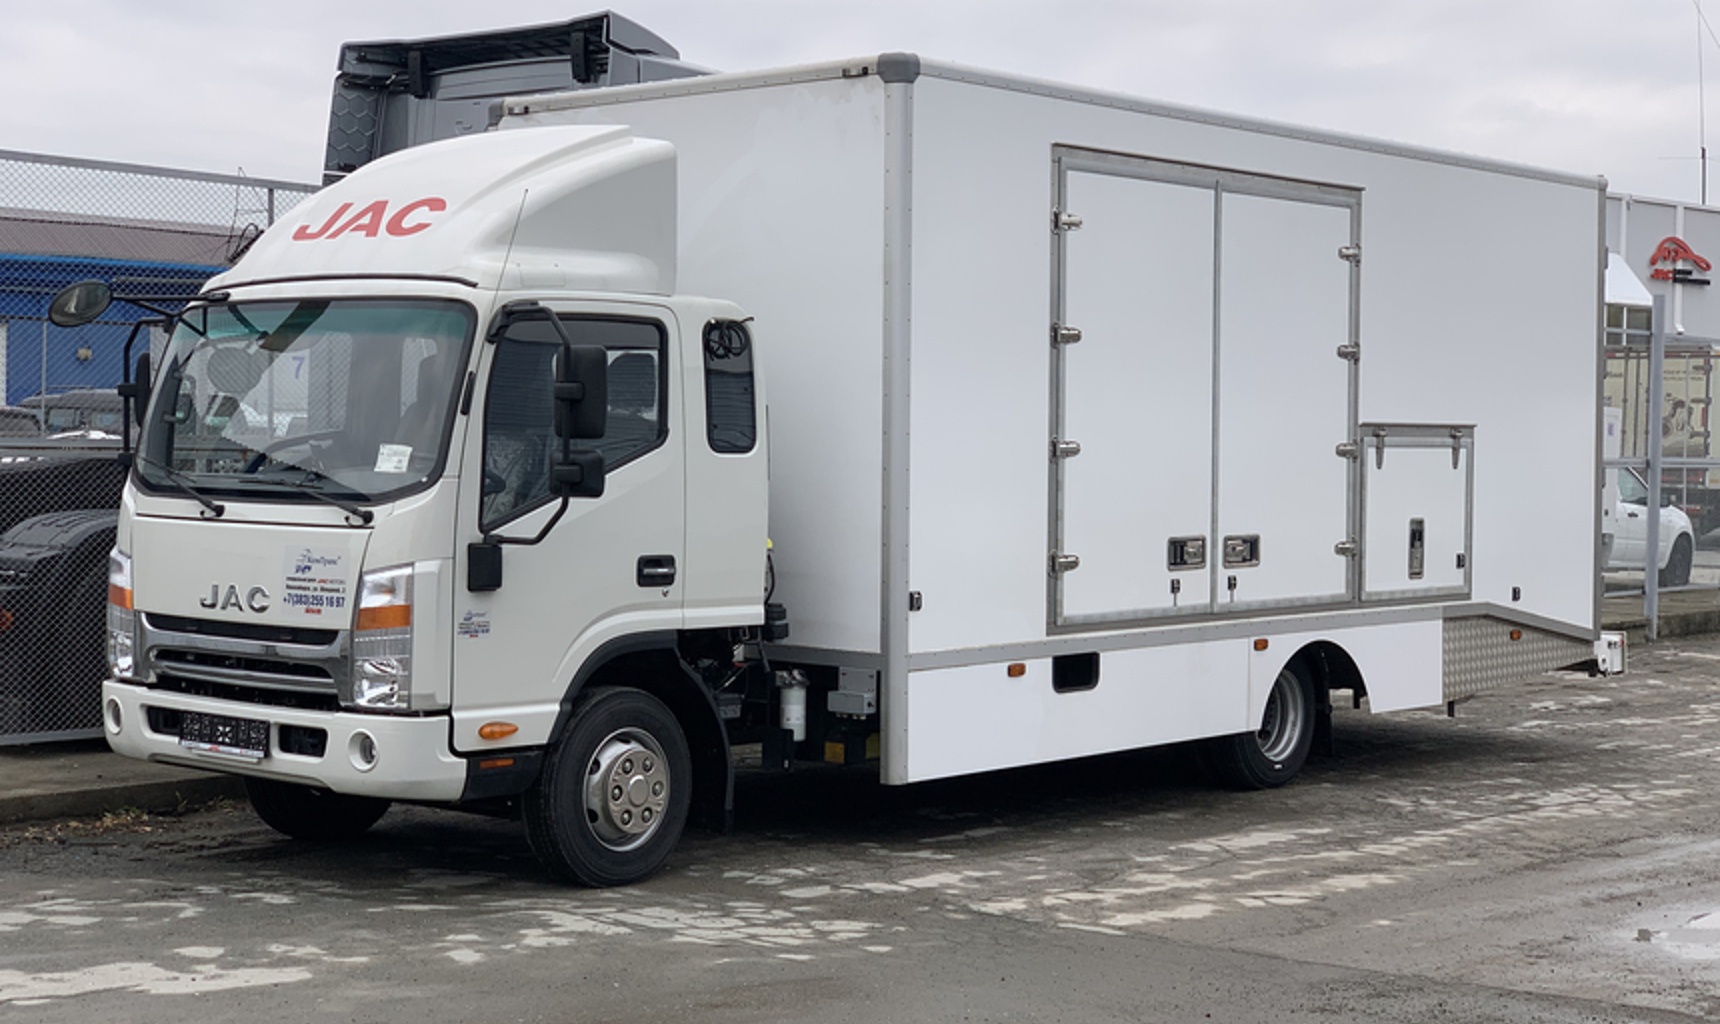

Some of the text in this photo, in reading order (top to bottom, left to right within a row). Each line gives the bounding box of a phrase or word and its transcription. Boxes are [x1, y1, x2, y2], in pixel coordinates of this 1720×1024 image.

[292, 197, 447, 241] JAC
[292, 356, 305, 379] 7
[199, 584, 271, 613] JAC
